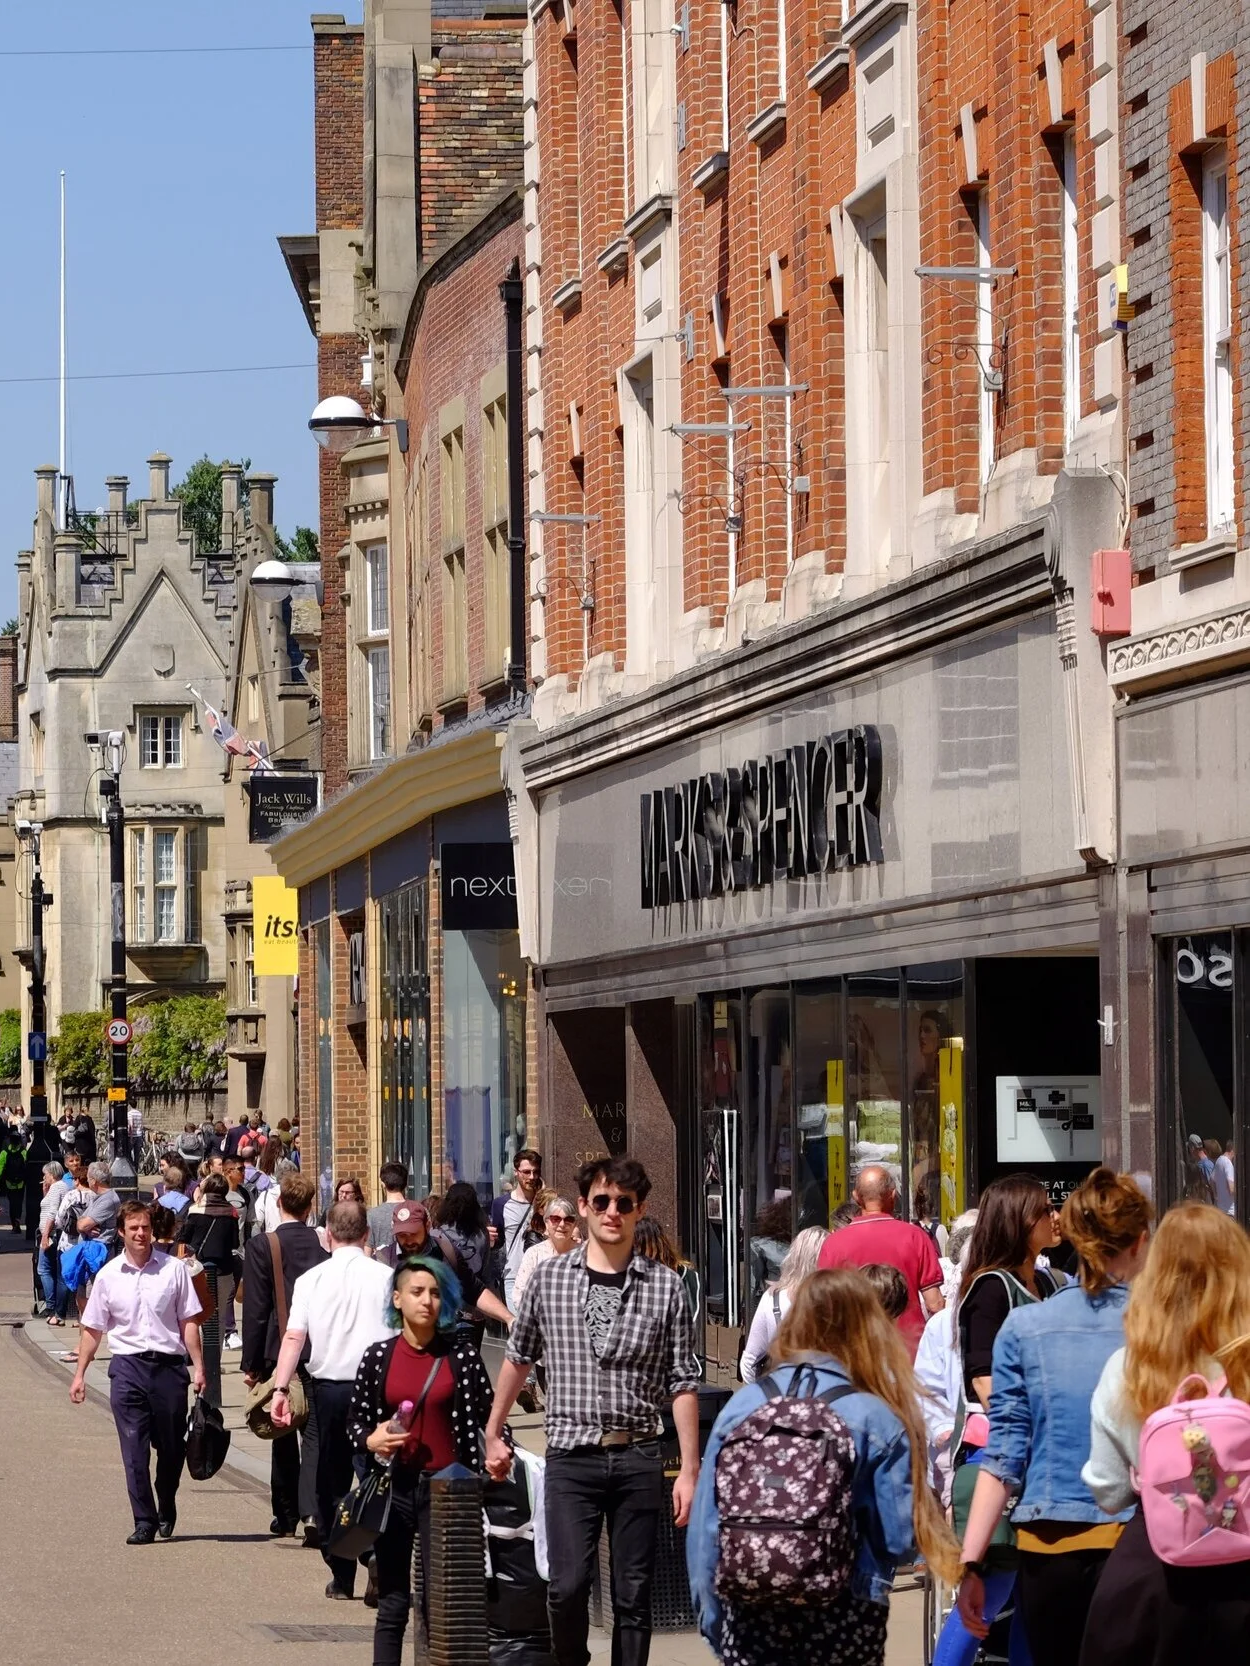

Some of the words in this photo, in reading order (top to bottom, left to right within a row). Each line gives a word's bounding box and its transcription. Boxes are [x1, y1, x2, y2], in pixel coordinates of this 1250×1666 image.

[256, 792, 280, 806] Jack
[283, 793, 312, 804] Wills
[450, 875, 517, 897] next
[265, 914, 298, 938] its
[111, 1025, 128, 1036] 20
[1053, 1181, 1065, 1189] AT
